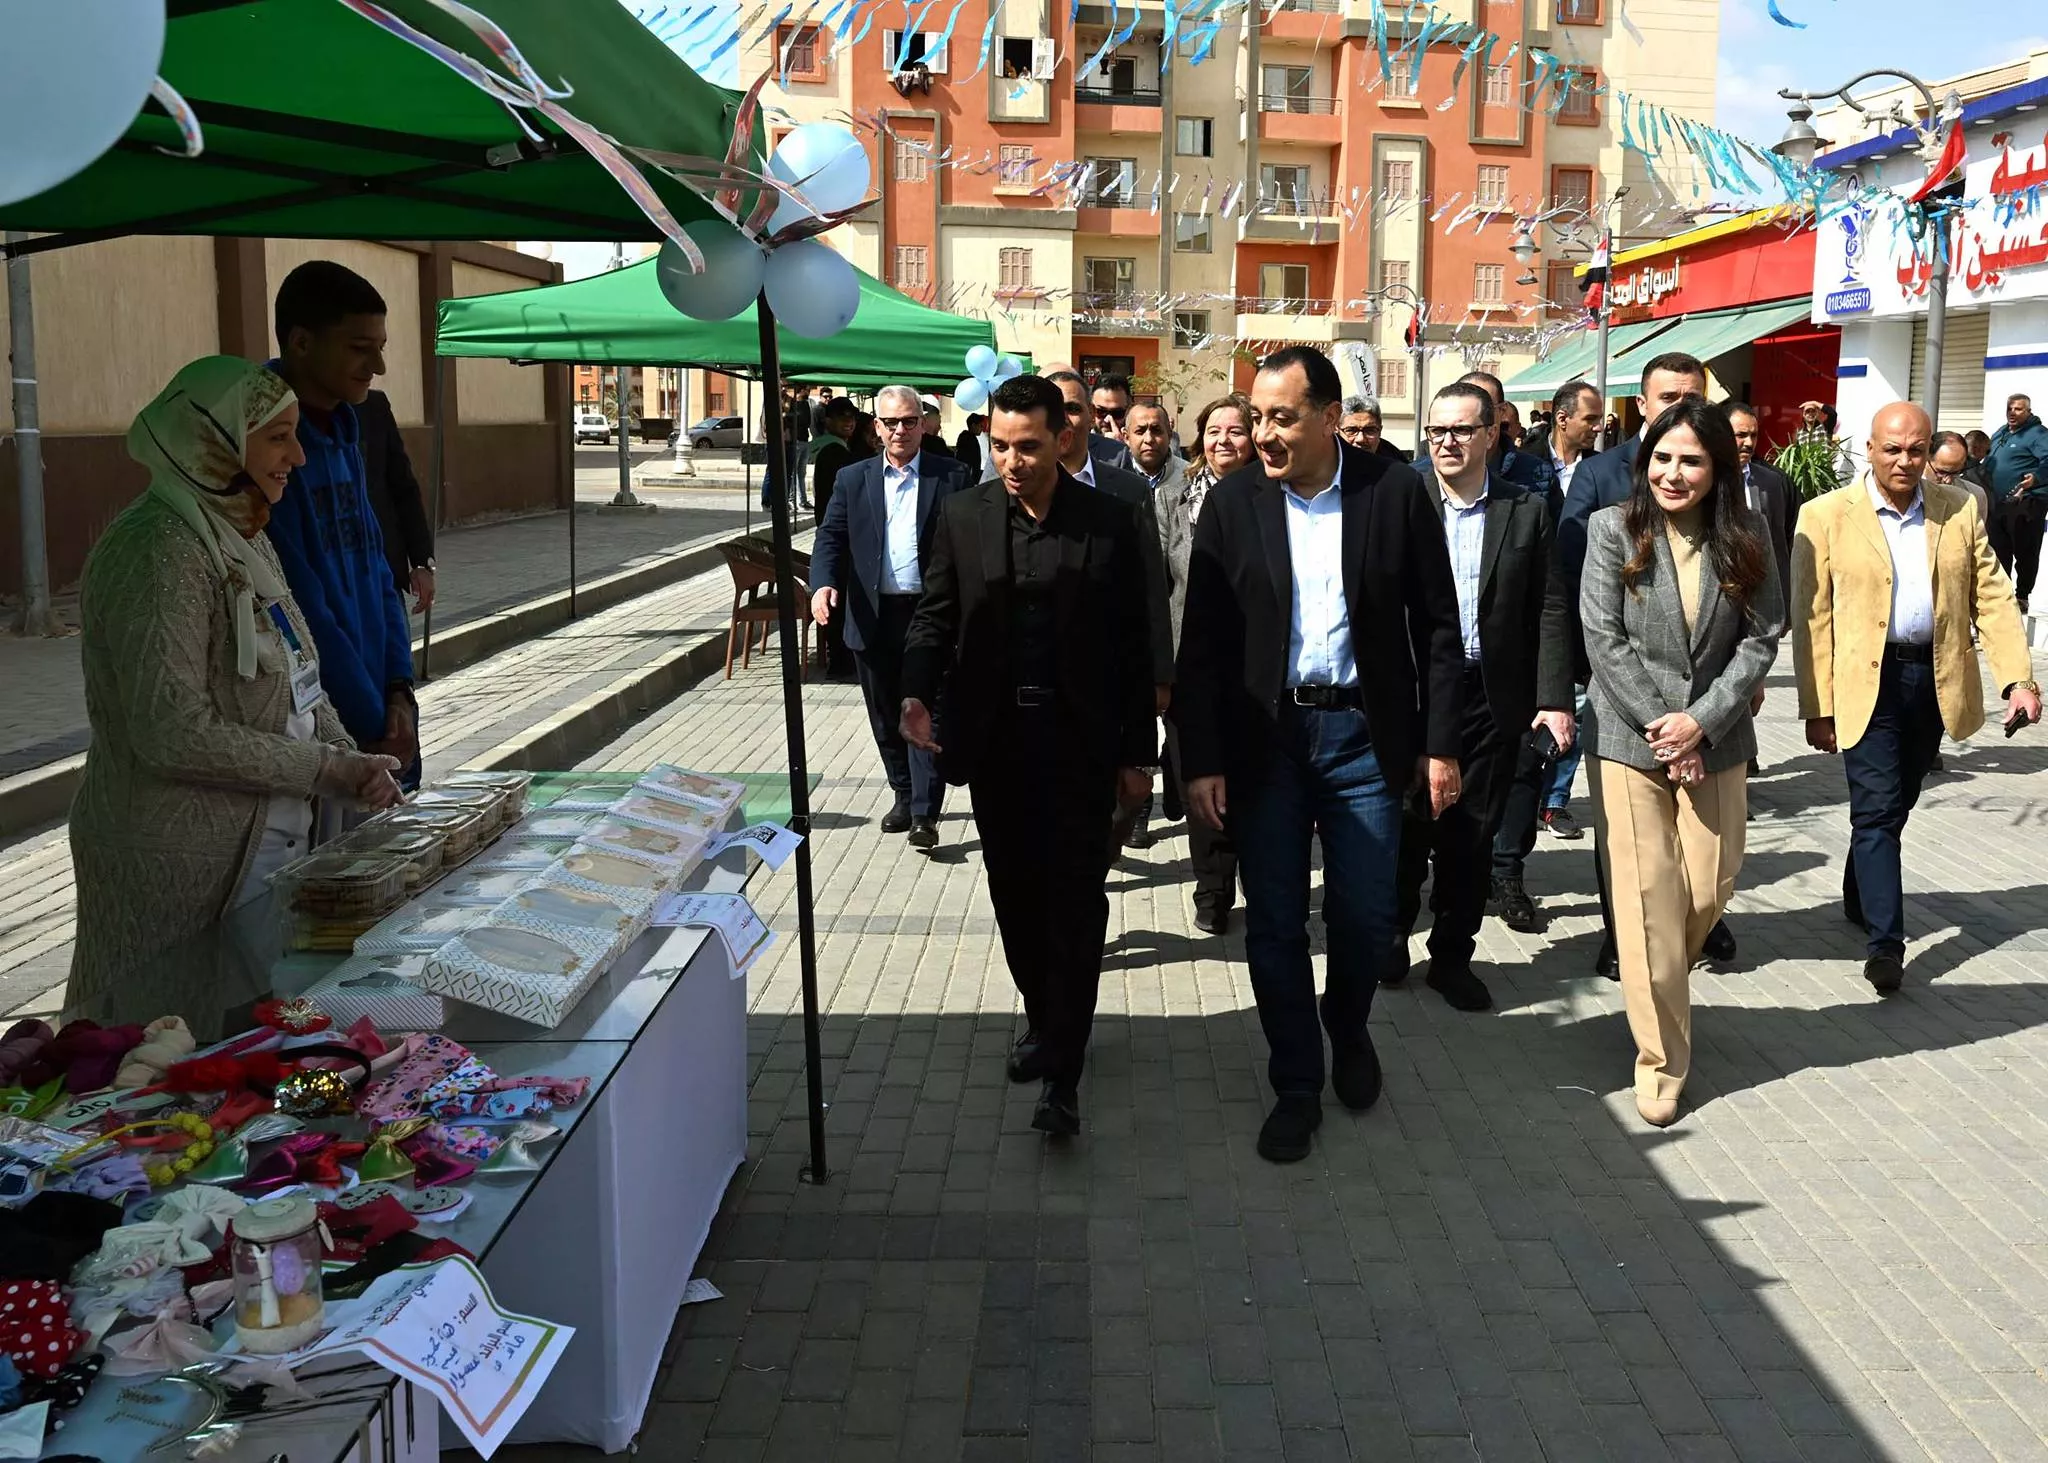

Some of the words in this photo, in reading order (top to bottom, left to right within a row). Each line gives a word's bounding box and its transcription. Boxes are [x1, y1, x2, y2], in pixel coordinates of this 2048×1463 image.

[1636, 255, 1680, 305] أسواق
[1826, 290, 1870, 312] 01034665511
[1355, 354, 1366, 374] مصر
